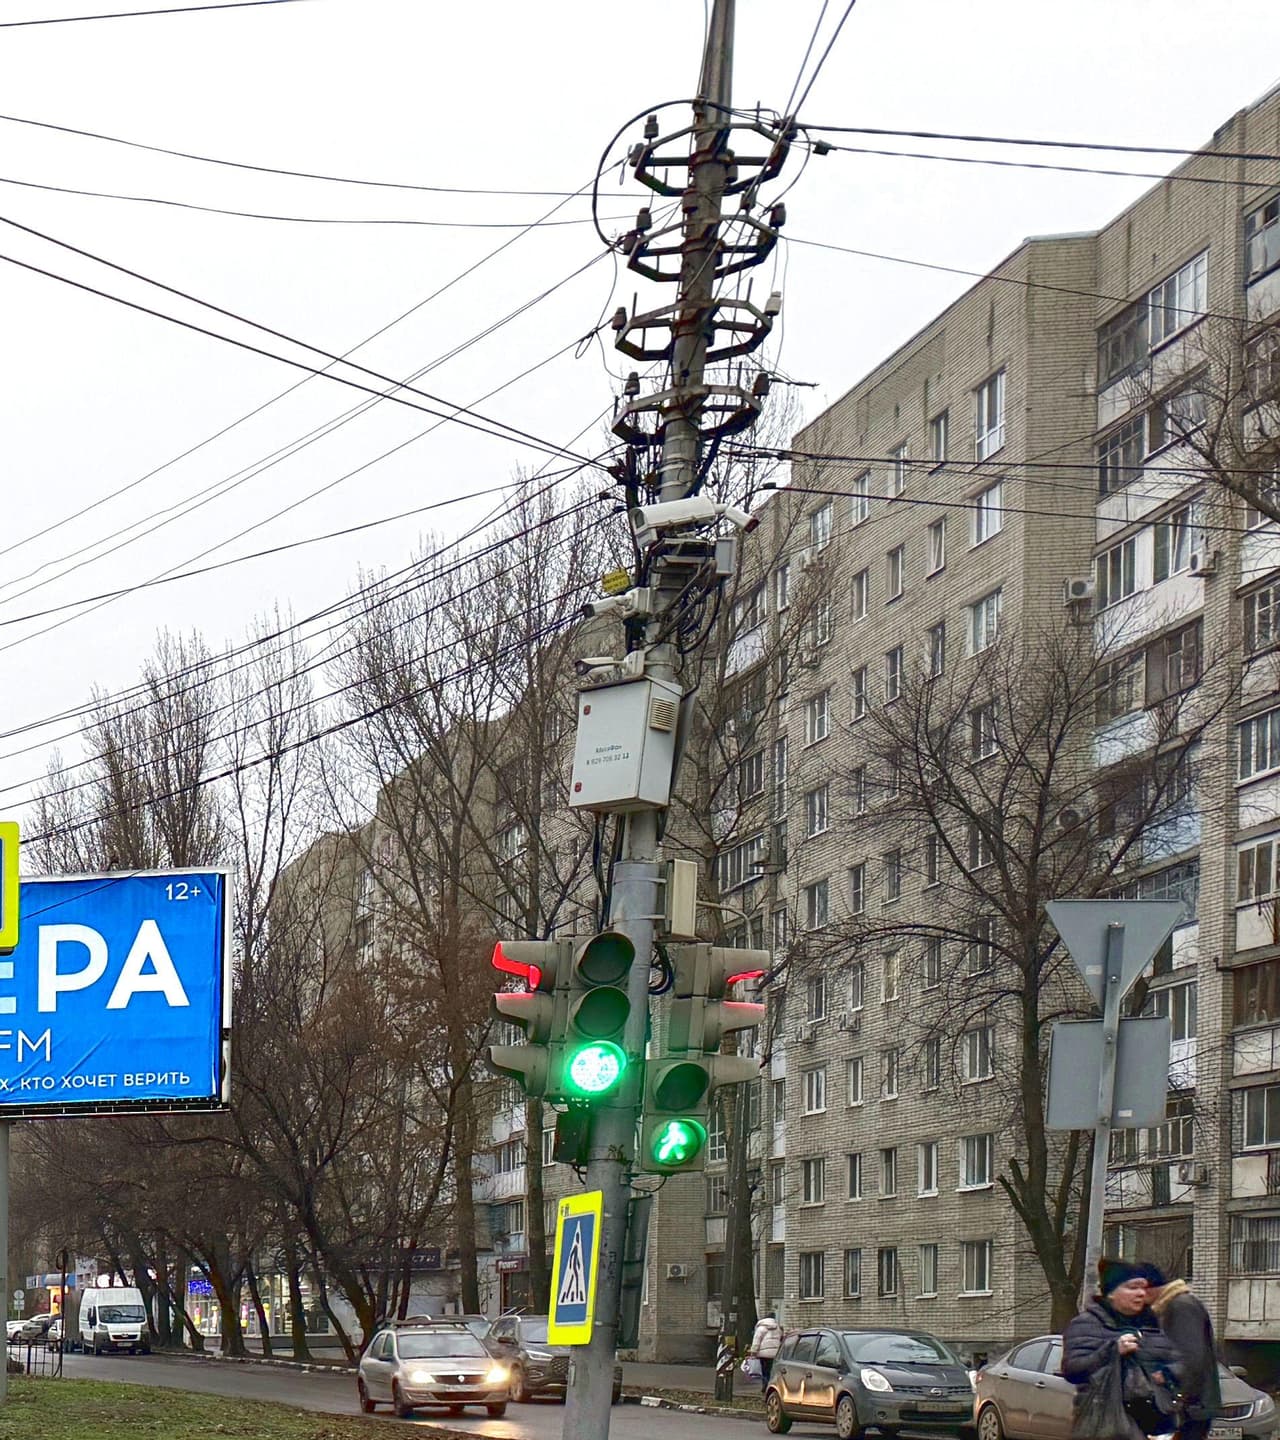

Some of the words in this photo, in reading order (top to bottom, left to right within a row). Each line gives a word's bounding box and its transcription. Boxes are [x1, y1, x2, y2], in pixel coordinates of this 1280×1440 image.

[165, 882, 201, 901] 12+
[20, 1074, 55, 1090] КТО
[61, 1073, 117, 1088] ХОЧЕТ
[124, 1070, 191, 1086] ВЕРИТЬ
